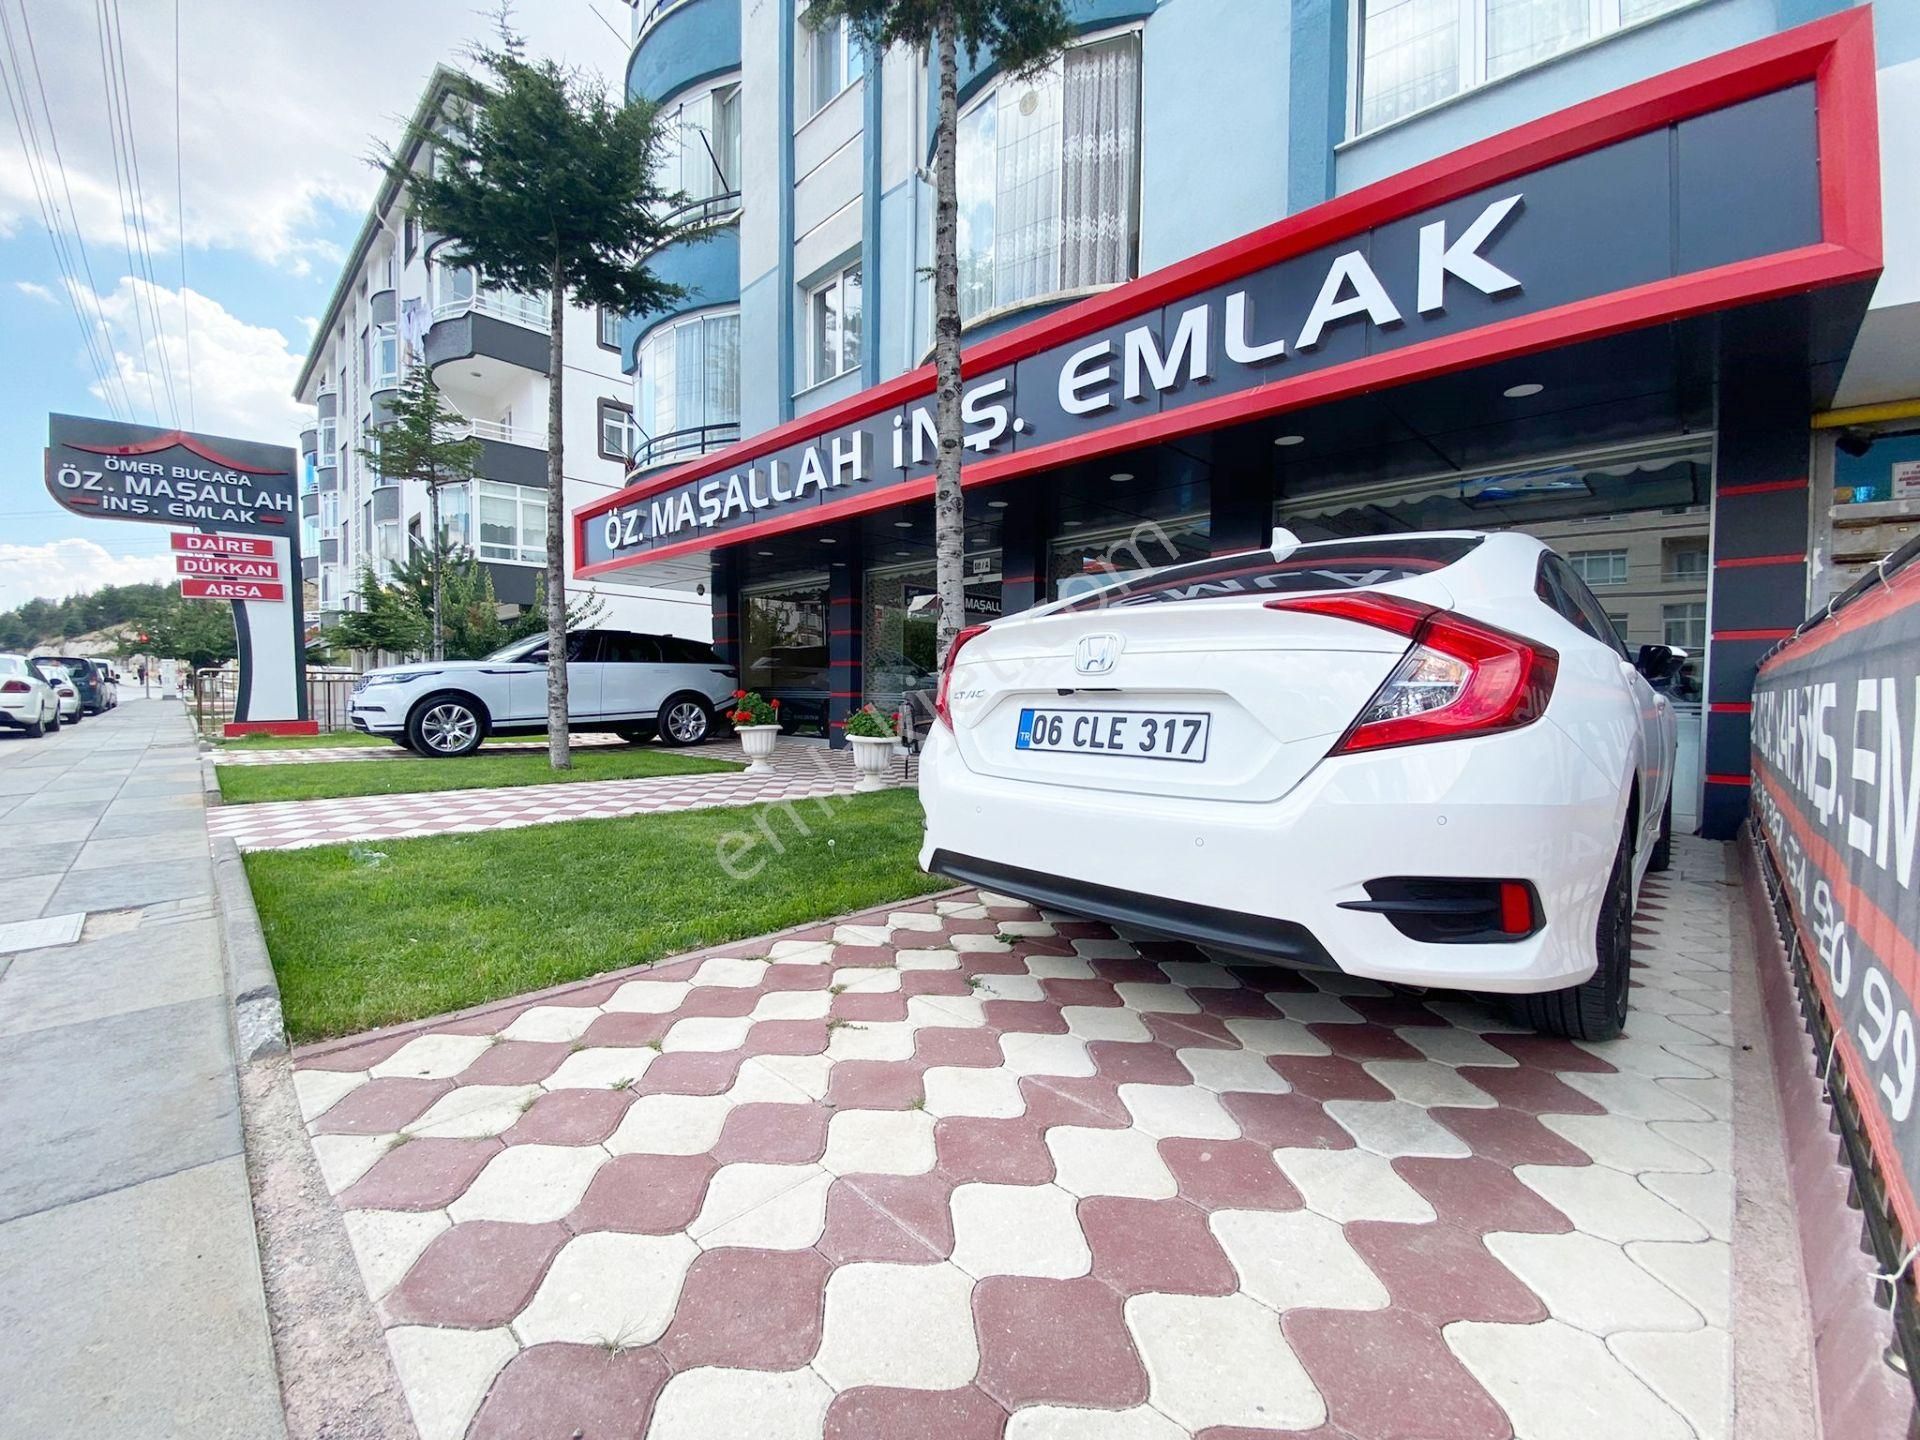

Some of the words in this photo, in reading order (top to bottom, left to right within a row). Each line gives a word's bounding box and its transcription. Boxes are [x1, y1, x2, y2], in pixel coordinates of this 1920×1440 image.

[604, 509, 644, 550] ÖZ.
[651, 430, 863, 528] MAŞALLAH
[1058, 193, 1524, 415] EMLAK
[104, 455, 164, 476] ÖMER
[172, 466, 252, 487] BUCAĞA
[57, 463, 115, 492] ÖZ.
[125, 475, 293, 512] MAŞALLAH
[167, 504, 256, 524] EMLAK
[186, 535, 255, 554] DAİRE
[183, 558, 272, 578] DÜKKAN
[204, 583, 262, 598] ARSA
[1019, 731, 1031, 742] TR
[1031, 714, 1063, 746] 06
[1073, 716, 1127, 750] CLE
[1139, 718, 1202, 755] 317
